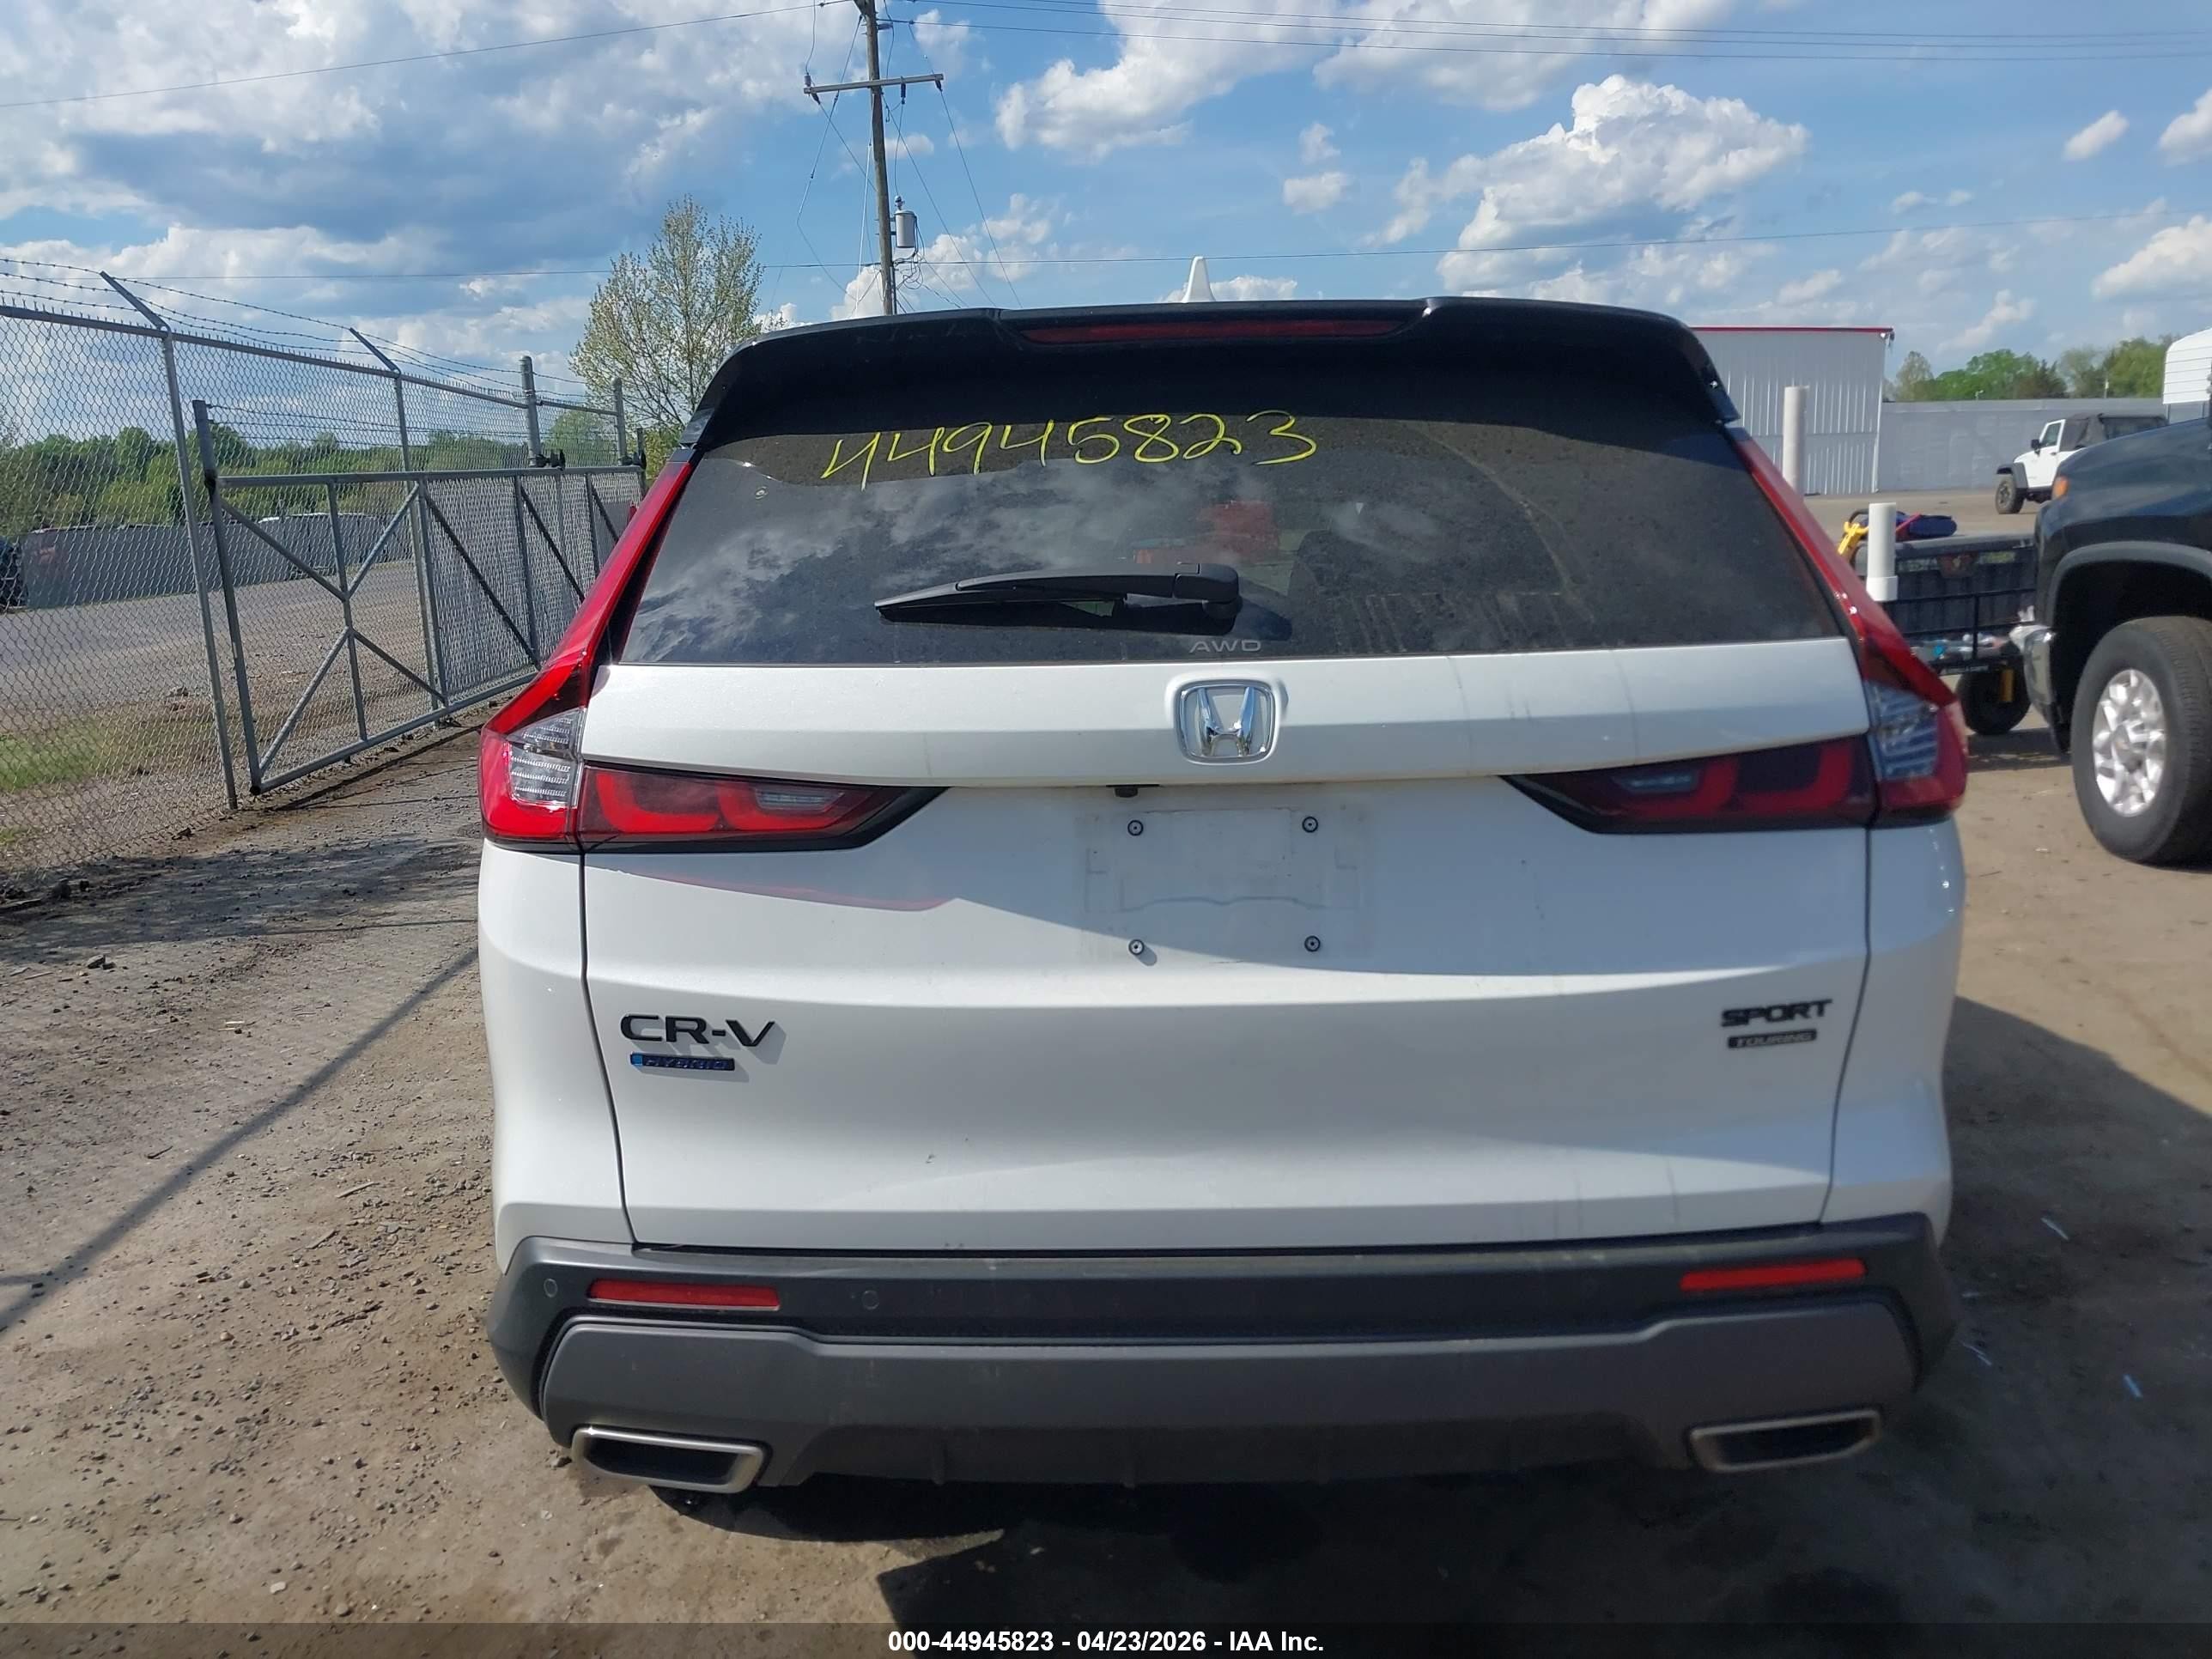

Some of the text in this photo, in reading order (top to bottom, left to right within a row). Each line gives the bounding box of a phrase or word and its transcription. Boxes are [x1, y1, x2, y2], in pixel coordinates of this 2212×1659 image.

[822, 410, 1318, 492] 44945823
[1189, 639, 1261, 653] AWD
[1721, 998, 1832, 1028] SPORT
[620, 1014, 775, 1047] CR-V
